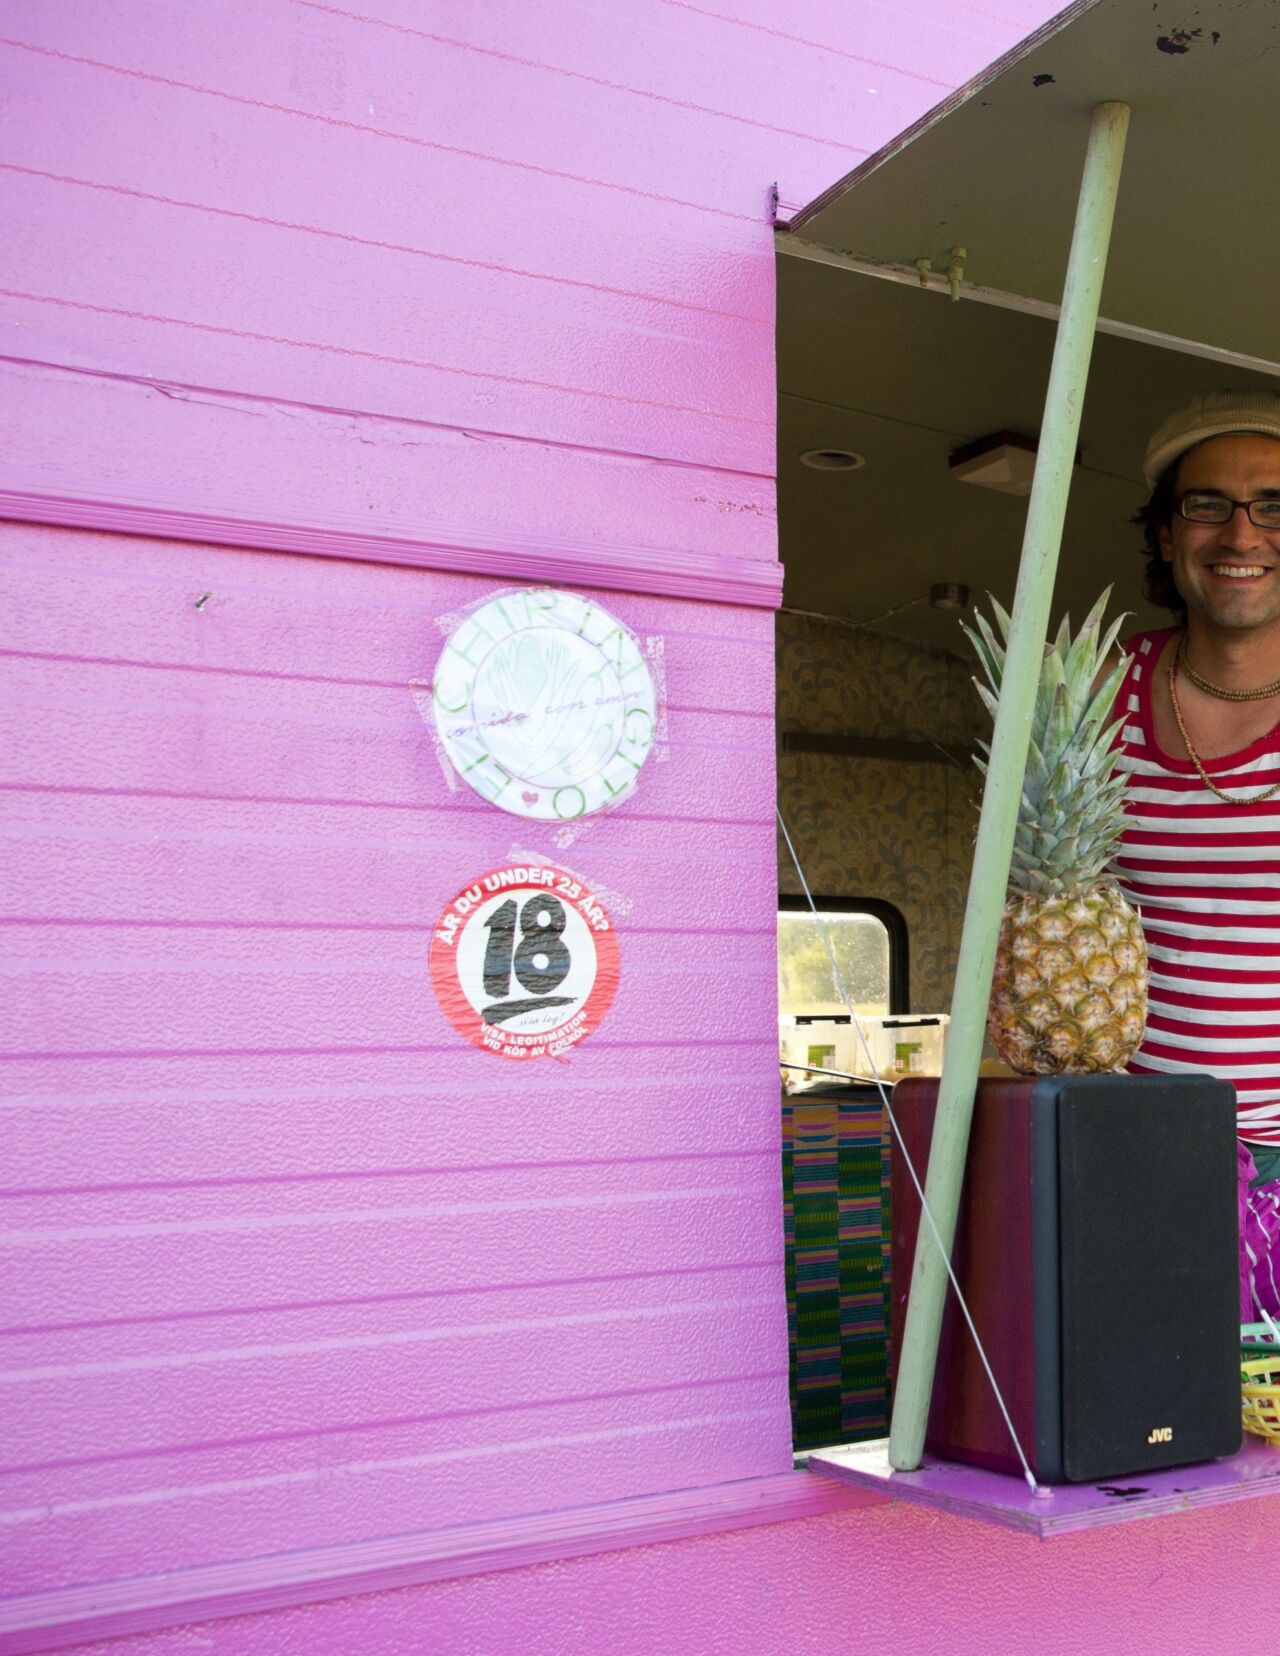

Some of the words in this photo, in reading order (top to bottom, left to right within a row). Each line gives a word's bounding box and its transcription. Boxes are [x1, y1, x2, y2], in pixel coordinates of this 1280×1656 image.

[445, 711, 530, 739] comida
[545, 700, 587, 714] con
[595, 690, 646, 706] amor
[435, 912, 463, 945] ÄR
[454, 885, 482, 914] DU
[483, 867, 556, 892] UNDER
[556, 876, 583, 899] 25
[576, 894, 610, 931] ÅR?
[483, 893, 572, 999] 18
[480, 1023, 506, 1042] VISA
[510, 1011, 588, 1046] LEGITIMATION
[483, 1036, 502, 1050] VID
[503, 1044, 527, 1057] KÖP
[531, 1046, 546, 1056] AV
[1147, 1427, 1173, 1444] JVC
